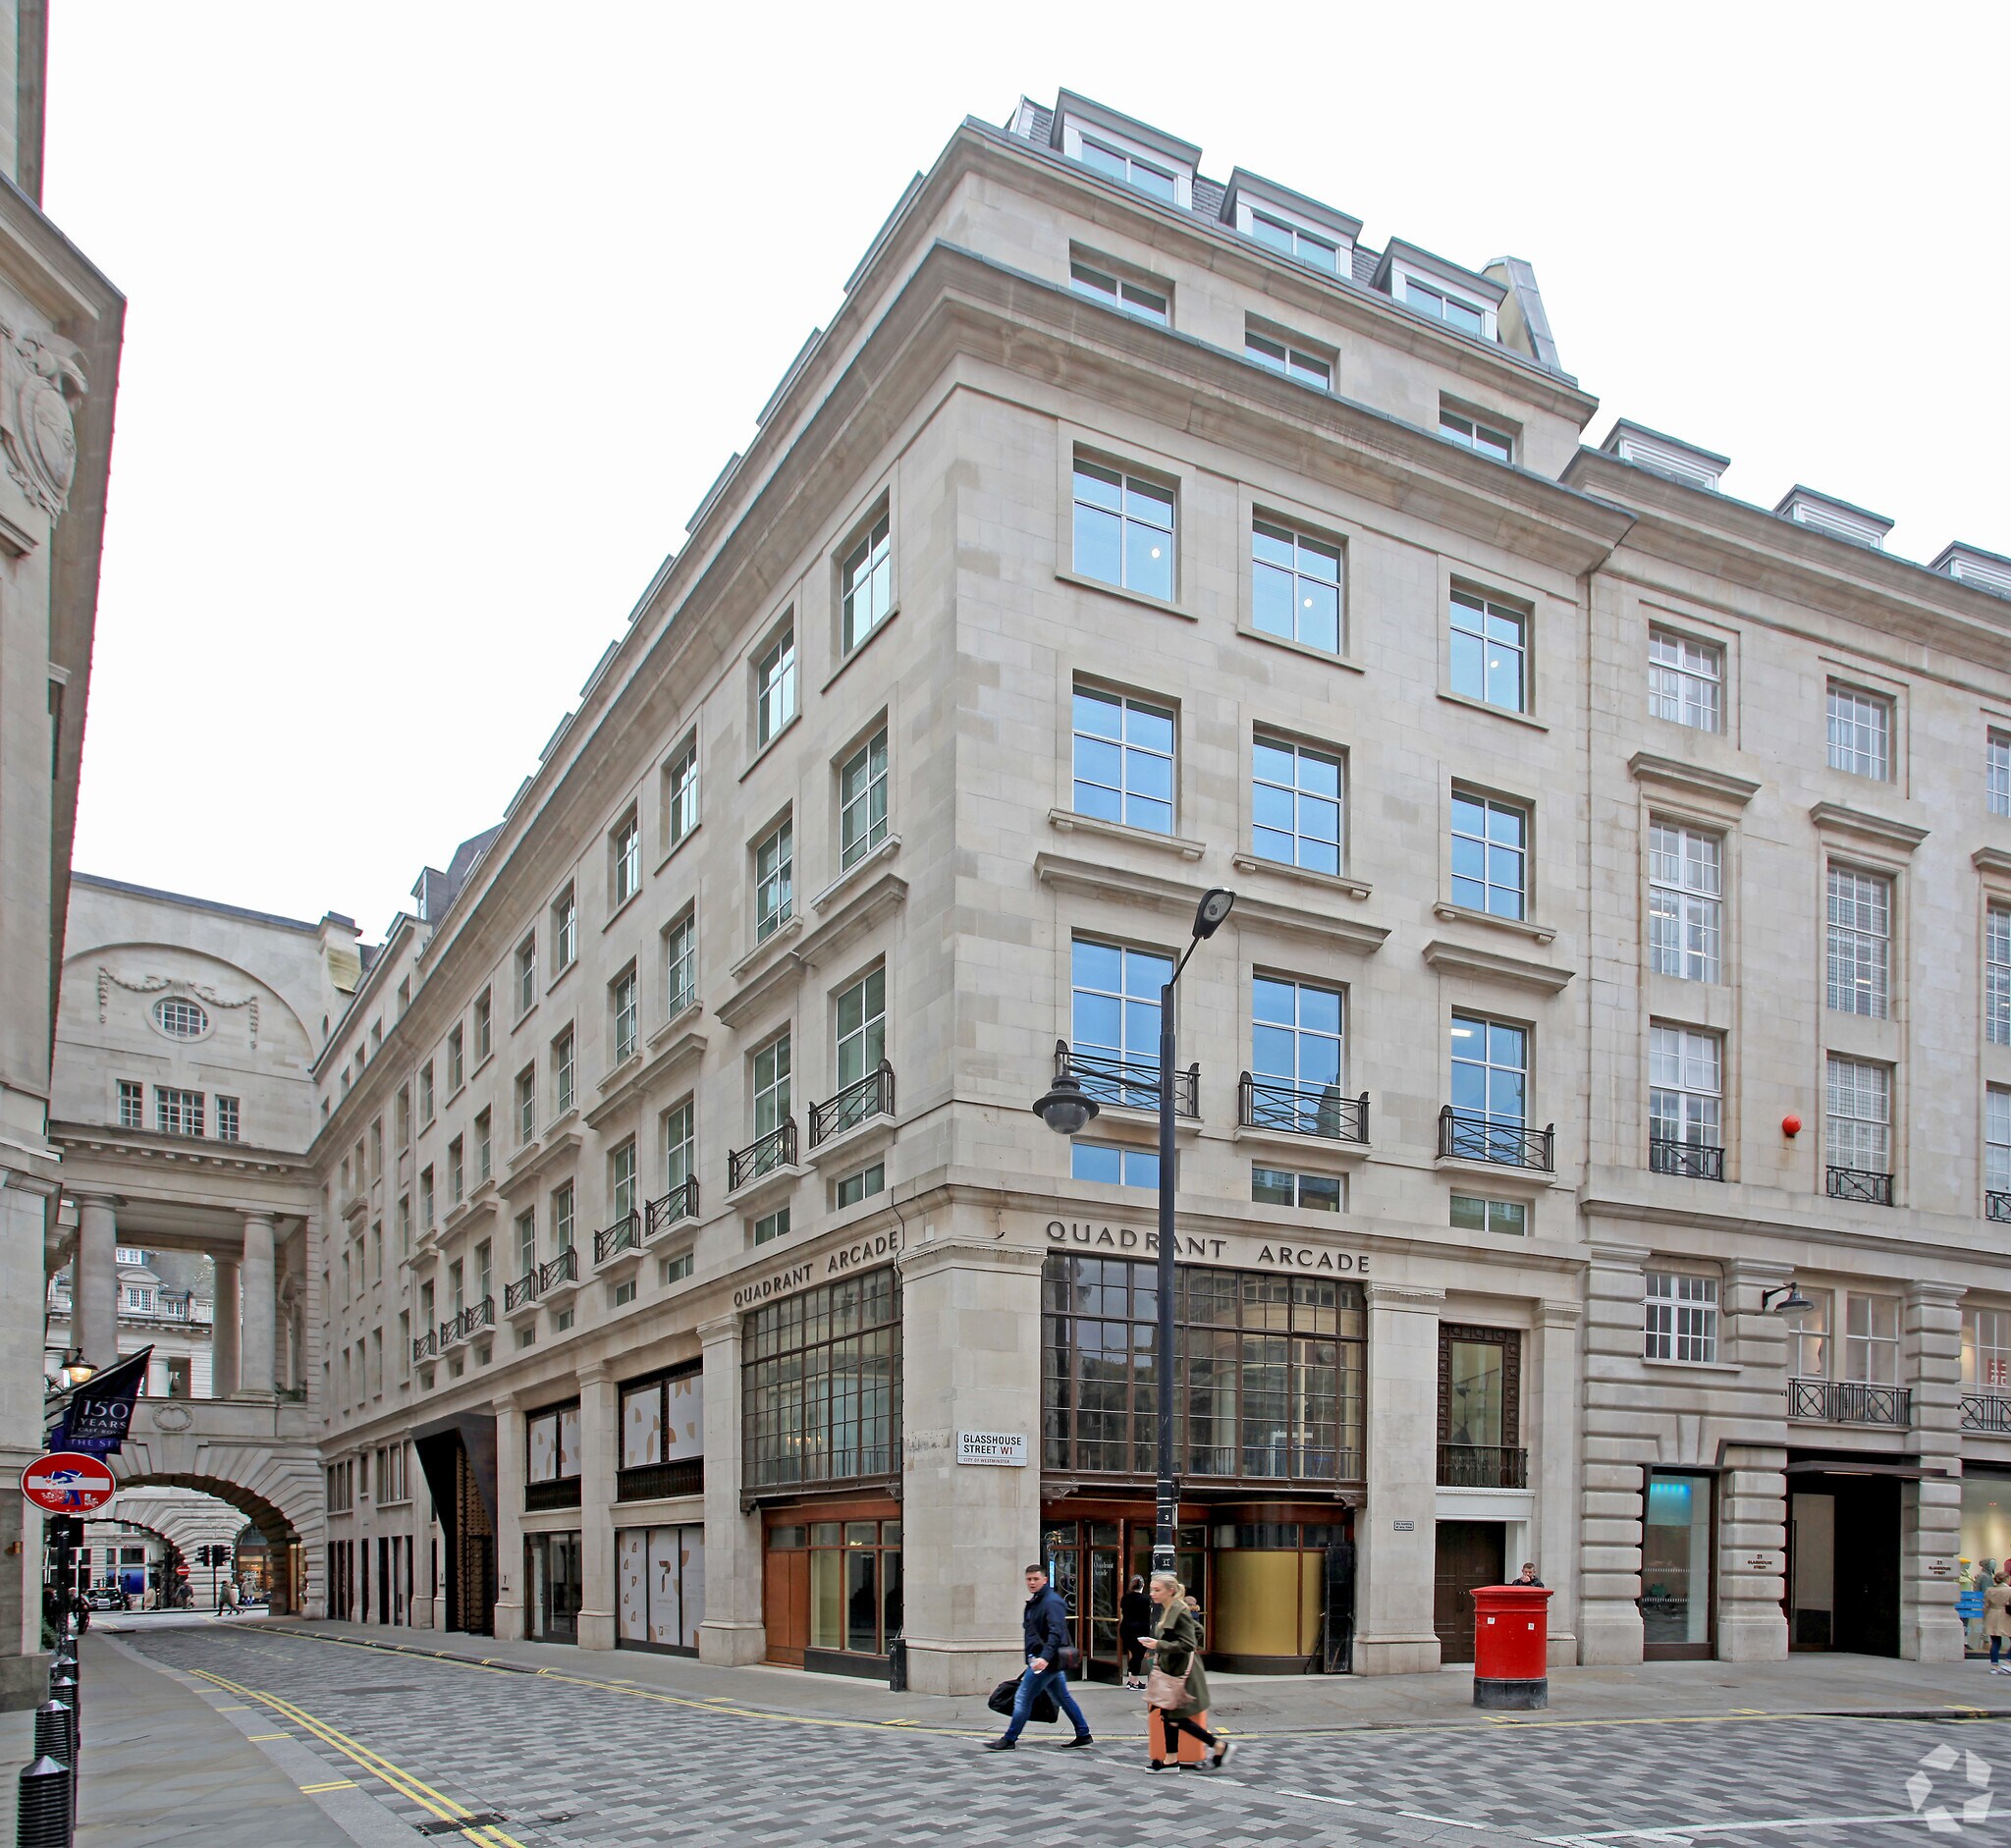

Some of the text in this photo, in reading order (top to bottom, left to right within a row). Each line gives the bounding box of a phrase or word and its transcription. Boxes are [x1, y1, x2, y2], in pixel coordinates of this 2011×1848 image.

[1257, 1244, 1370, 1273] ARCADE
[733, 1230, 898, 1307] QUADRANT ARCADE
[84, 1400, 129, 1419] 150
[81, 1418, 127, 1429] YEARS
[71, 1439, 93, 1447] THE
[963, 1434, 1022, 1446] GLASSHOUSE
[963, 1443, 1013, 1455] STREET W1
